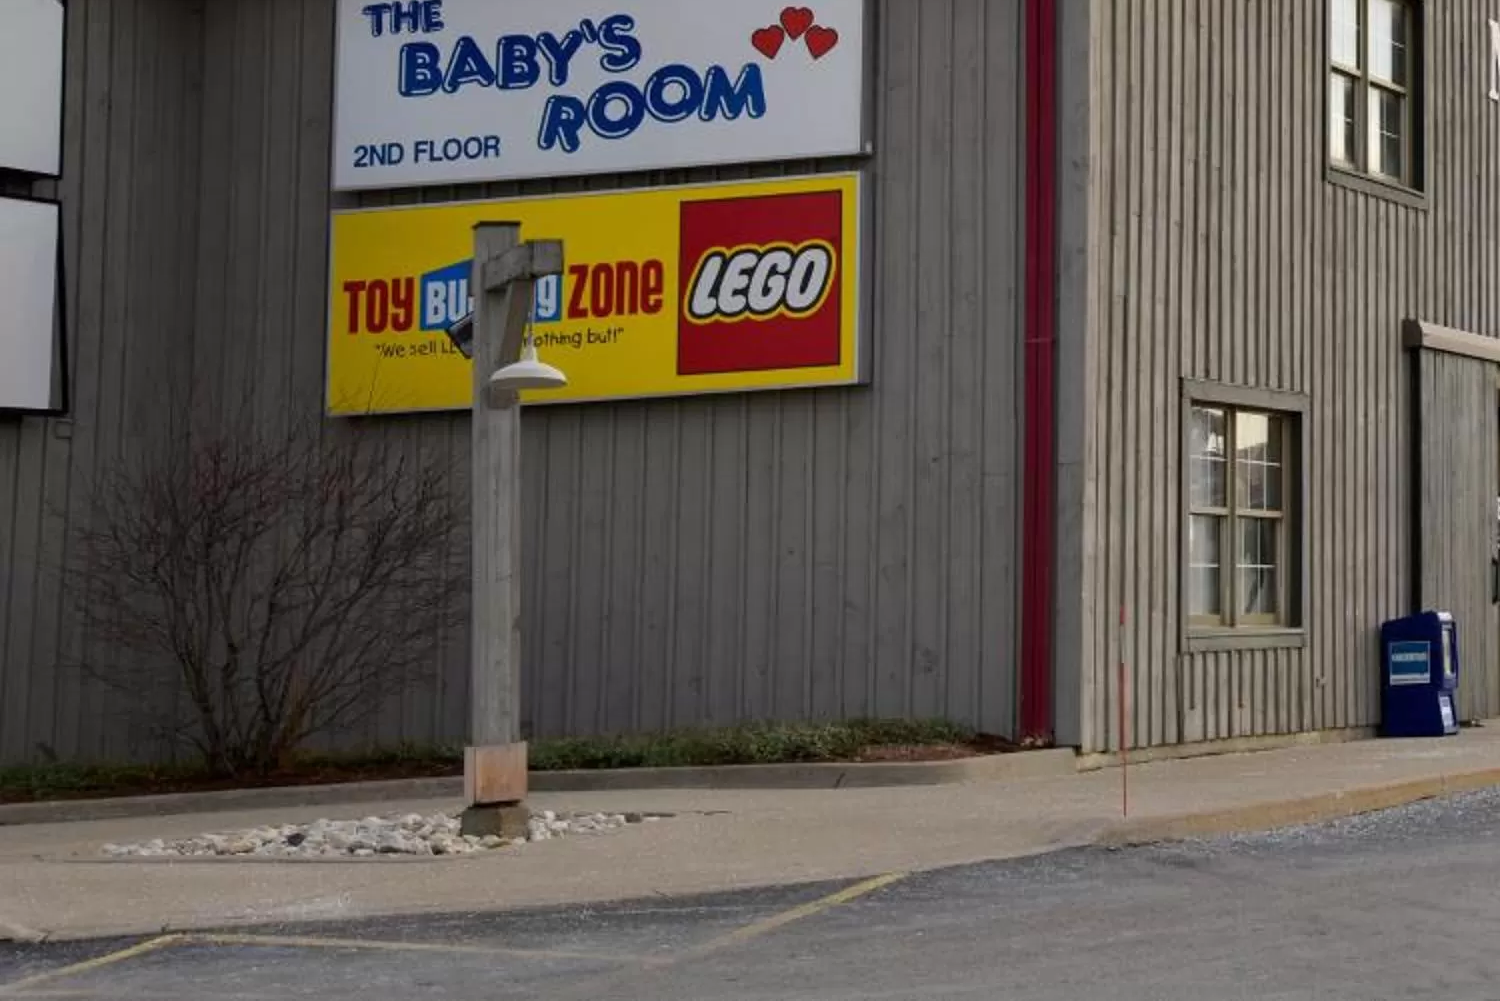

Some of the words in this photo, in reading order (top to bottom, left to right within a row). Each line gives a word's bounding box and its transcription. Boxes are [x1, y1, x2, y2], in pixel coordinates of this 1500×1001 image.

[398, 13, 642, 97] BABY'S
[538, 62, 767, 153] ROOM
[353, 142, 404, 168] 2ND
[414, 135, 501, 164] FLOOR
[689, 245, 830, 317] LEGO
[410, 339, 437, 356] sell
